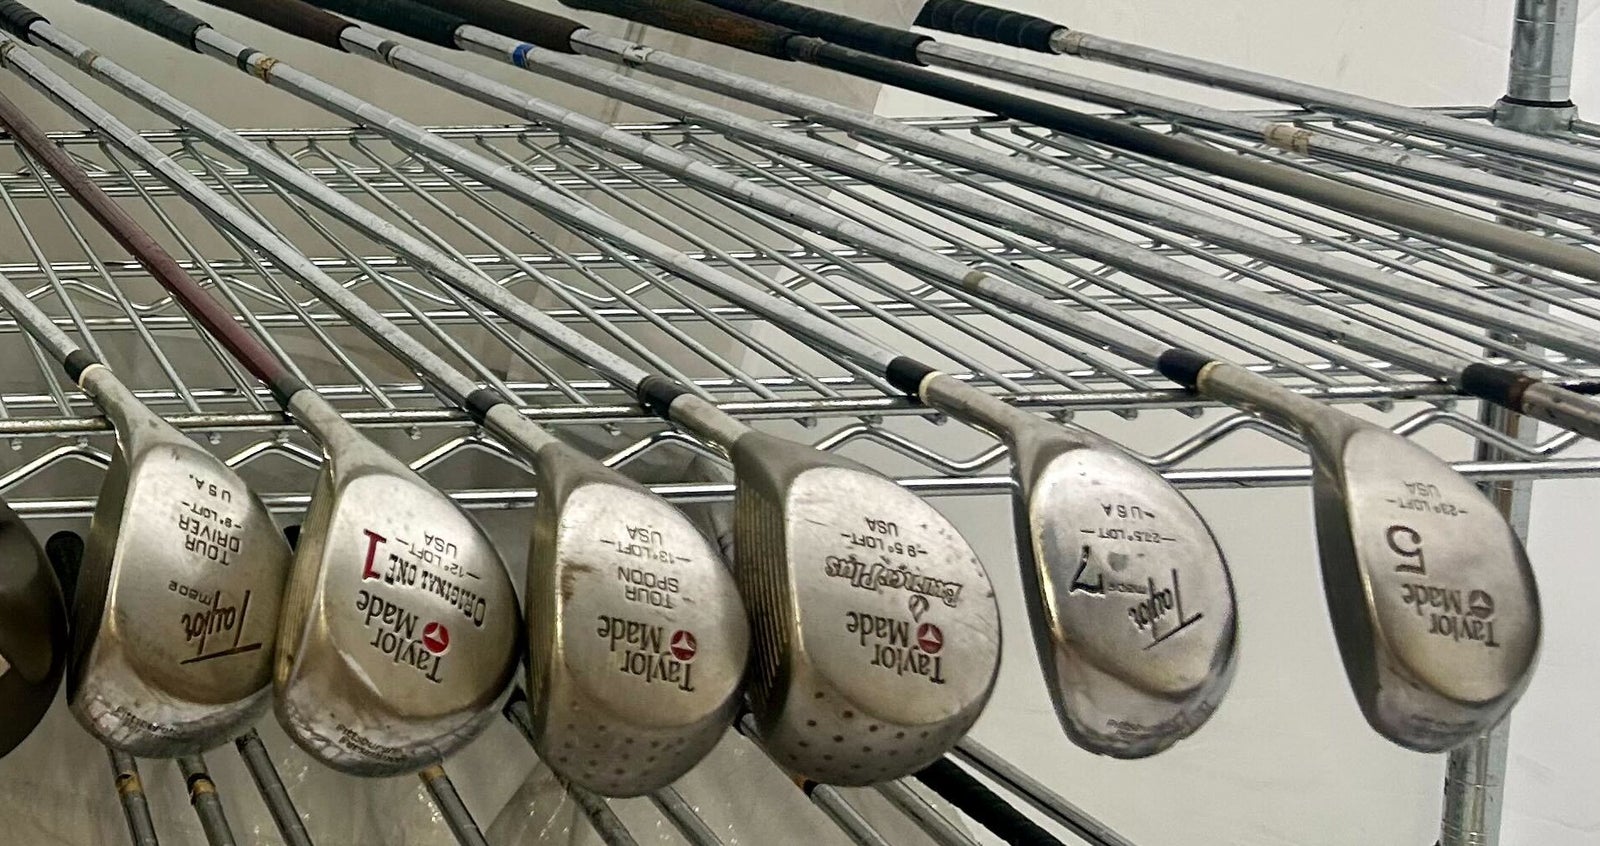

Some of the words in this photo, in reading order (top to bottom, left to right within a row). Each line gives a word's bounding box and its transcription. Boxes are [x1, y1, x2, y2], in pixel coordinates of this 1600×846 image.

[1403, 481, 1441, 500] USA
[178, 514, 240, 553] DRIVER
[423, 532, 457, 558] USA
[625, 526, 663, 548] USA
[865, 517, 898, 537] USA
[184, 535, 230, 566] TOUR
[362, 528, 387, 582] 1
[1386, 525, 1427, 575] 5
[384, 553, 417, 589] ONE
[617, 566, 679, 593] SPOON
[1069, 545, 1105, 596] 7
[355, 589, 419, 633] Made
[420, 568, 486, 628] ORIGINAL
[624, 585, 672, 609] TOUR
[1128, 569, 1203, 651] Taylor
[1402, 583, 1462, 612] Made
[179, 590, 262, 665] Taylor
[596, 615, 664, 653] Made
[846, 611, 909, 648] Made
[1428, 615, 1499, 648] Taylor
[370, 629, 442, 684] Taylor
[620, 650, 695, 692] Taylor
[870, 642, 945, 685] Taylor
